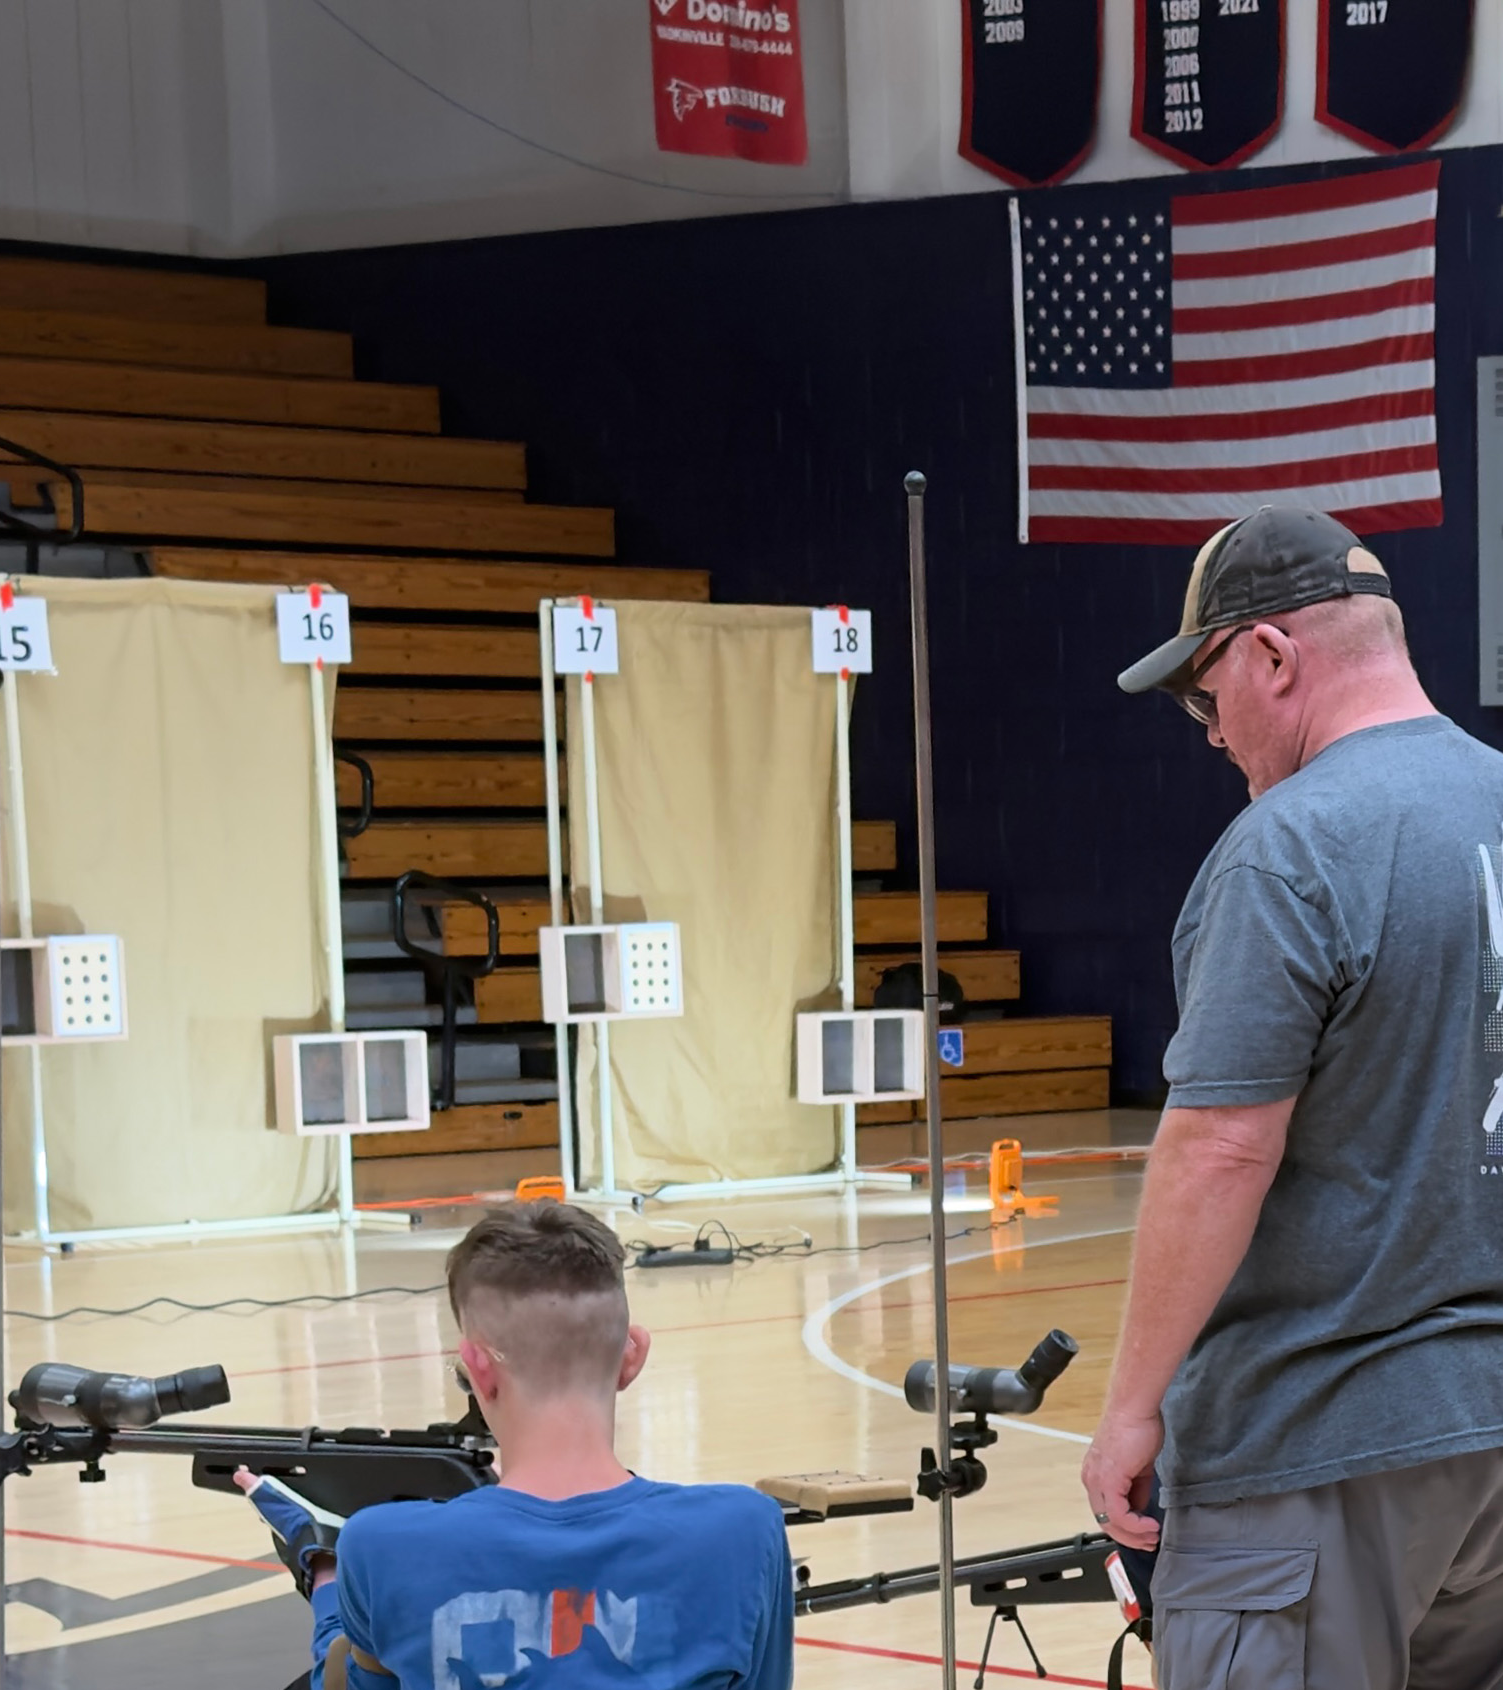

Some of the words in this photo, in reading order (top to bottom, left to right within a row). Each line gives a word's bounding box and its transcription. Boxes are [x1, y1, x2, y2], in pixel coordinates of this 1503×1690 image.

[1161, 0, 1201, 22] 1999
[1346, 1, 1388, 26] 2017
[1164, 80, 1201, 106] 2011
[1164, 108, 1203, 133] 2012
[302, 613, 334, 641] 16
[575, 627, 603, 652] 17
[833, 628, 858, 653] 18
